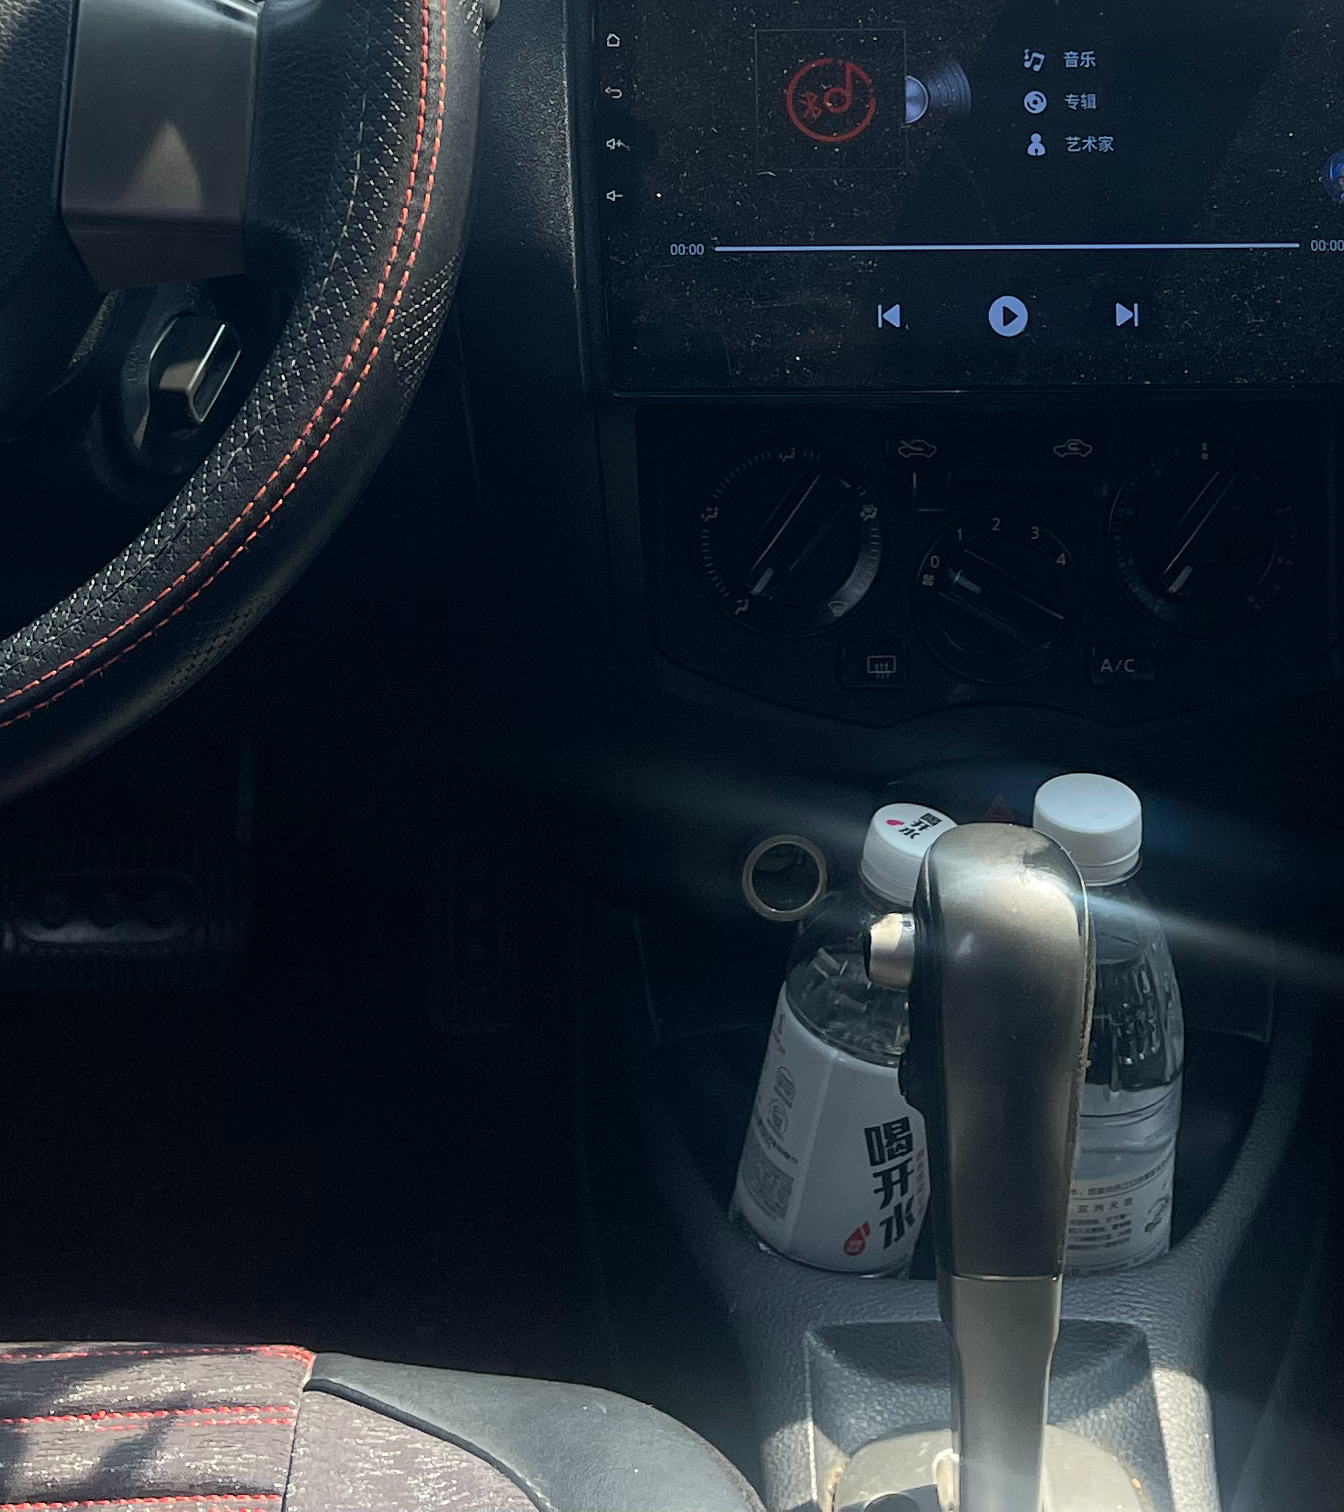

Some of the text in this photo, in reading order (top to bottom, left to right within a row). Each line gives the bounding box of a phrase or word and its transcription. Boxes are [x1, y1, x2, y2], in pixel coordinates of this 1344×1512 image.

[1063, 50, 1097, 68] 音乐
[1064, 92, 1097, 111] 专辑
[1065, 135, 1115, 153] 艺术家
[670, 243, 705, 256] 00:00
[991, 518, 1001, 531] 2
[956, 528, 963, 541] 1
[1030, 526, 1040, 539] 3
[930, 555, 940, 568] 0
[1056, 553, 1067, 566] 4
[1100, 658, 1136, 673] A/C
[863, 1115, 915, 1251] 喝开水
